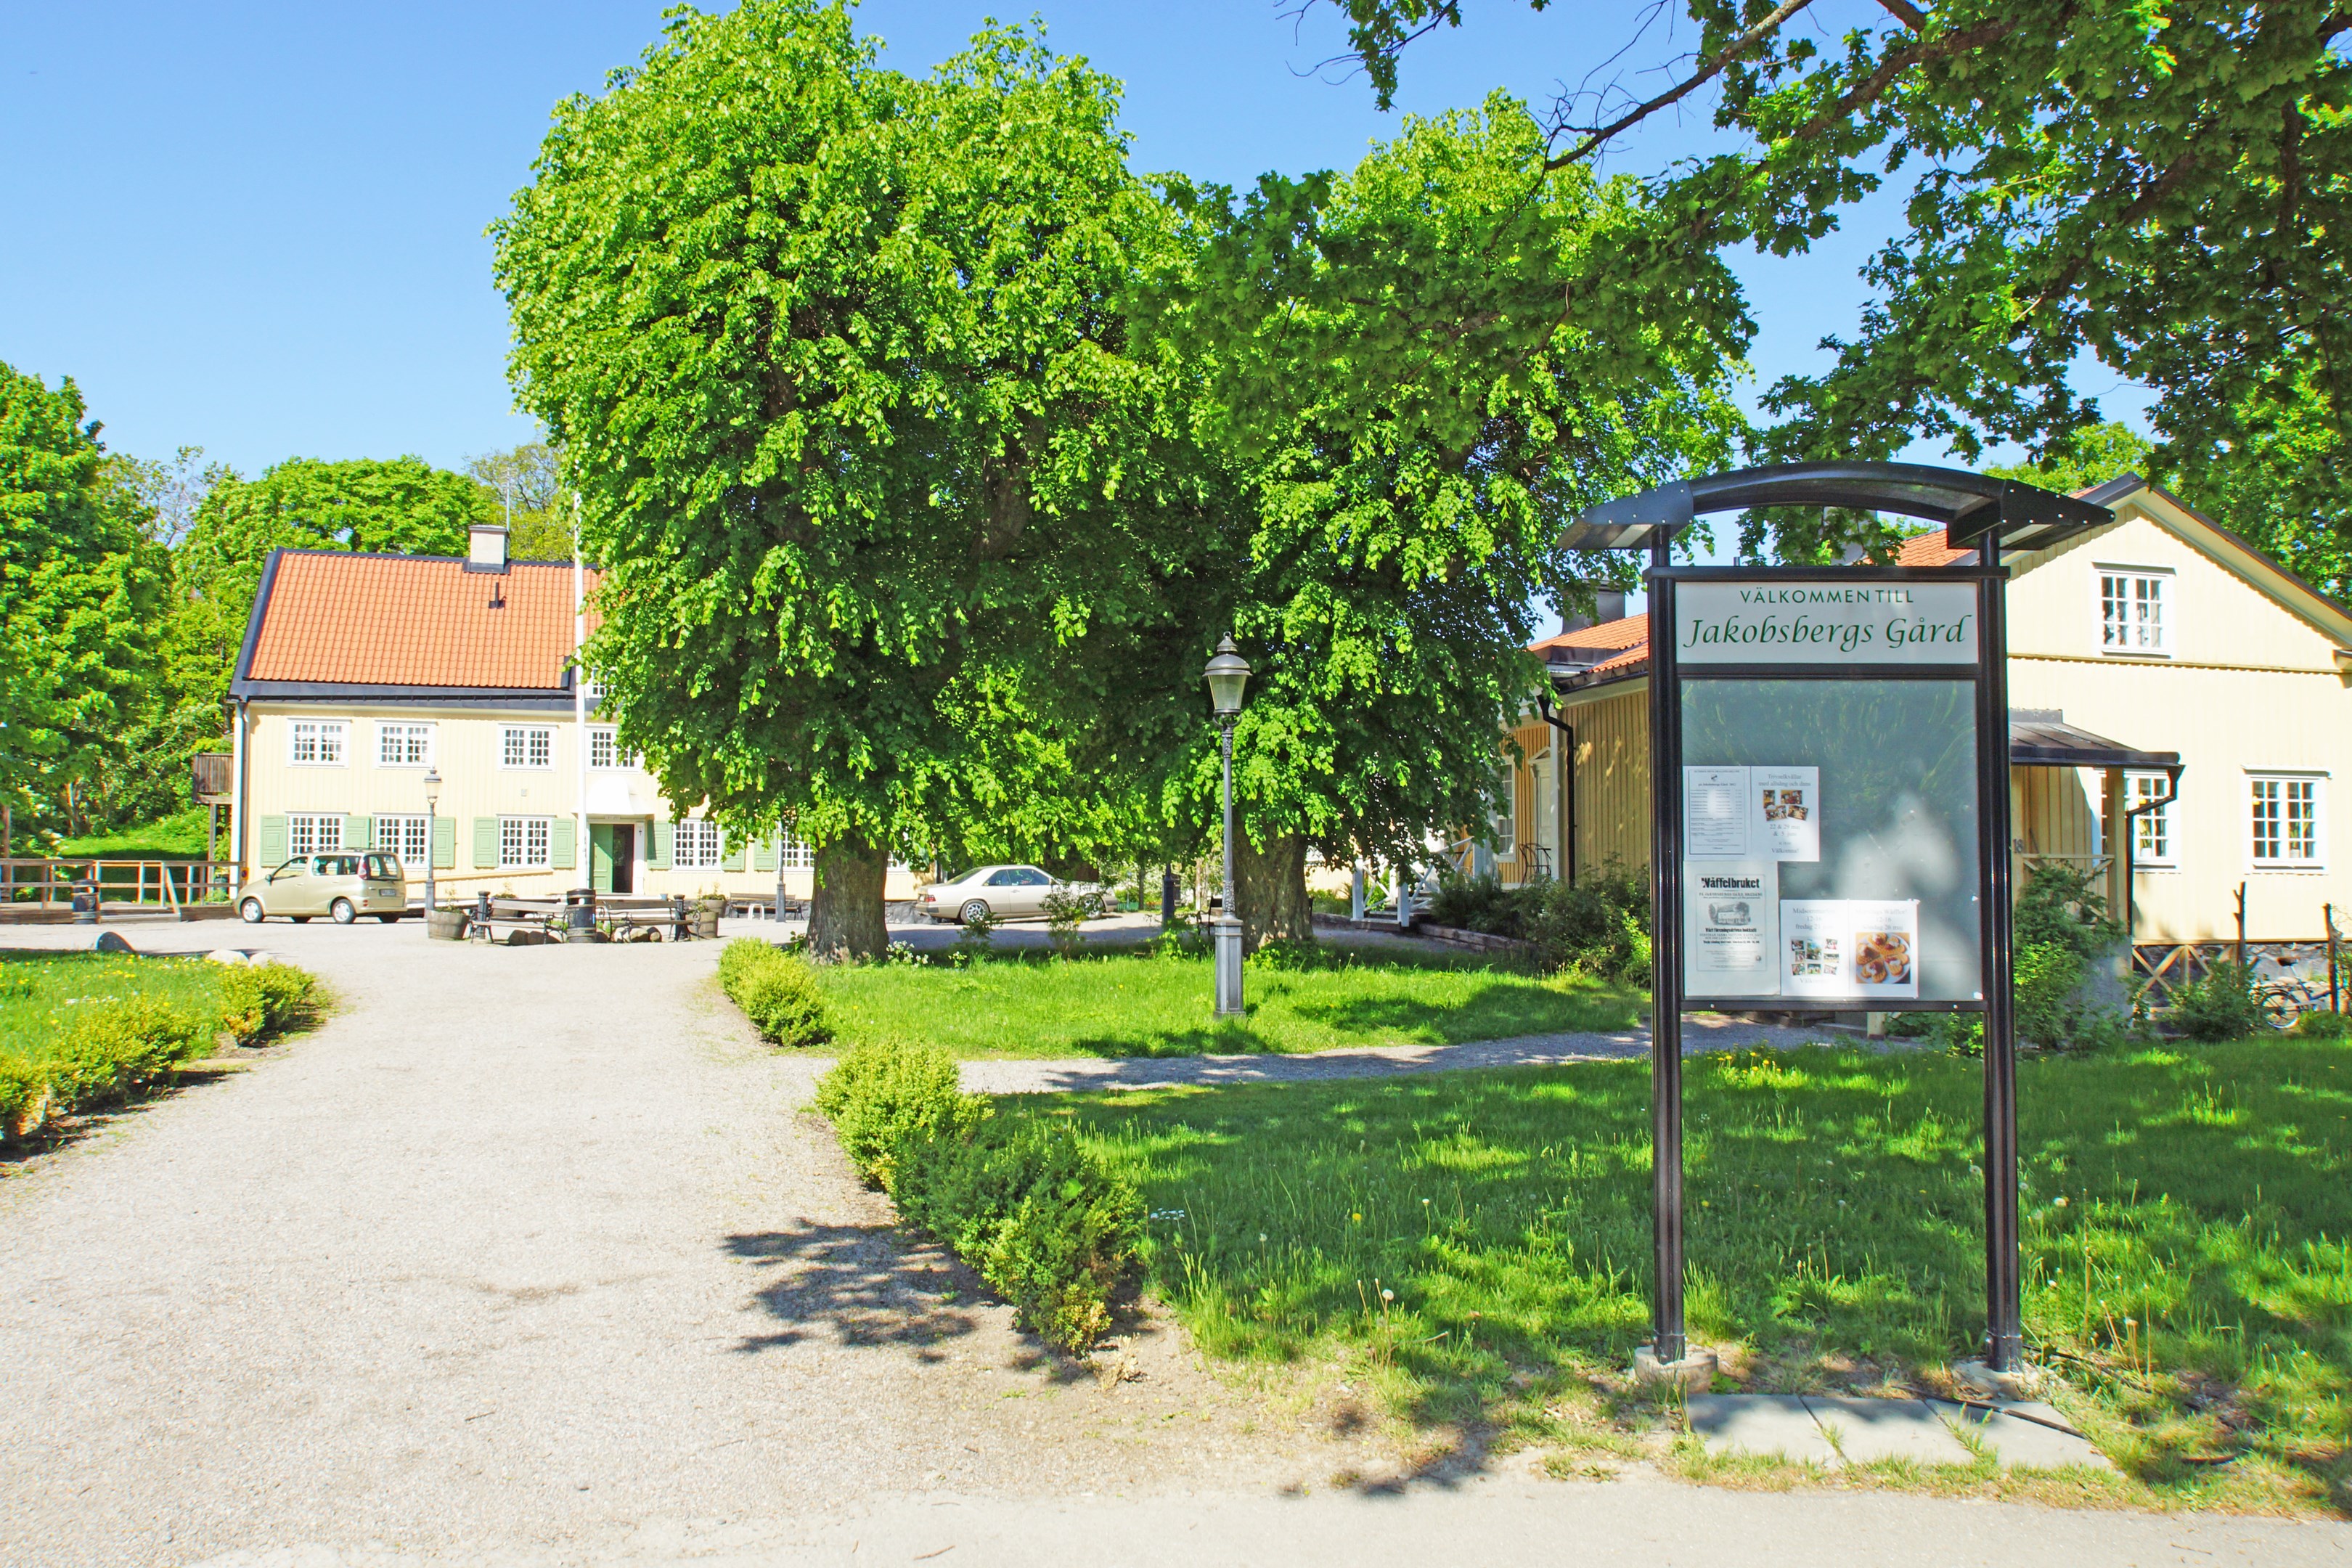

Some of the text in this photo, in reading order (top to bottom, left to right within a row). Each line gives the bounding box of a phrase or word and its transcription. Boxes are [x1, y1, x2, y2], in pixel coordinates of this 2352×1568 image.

[1740, 587, 1914, 603] VÄLKOMMEN TILL
[1683, 615, 1972, 652] Jakobsbergs Gård
